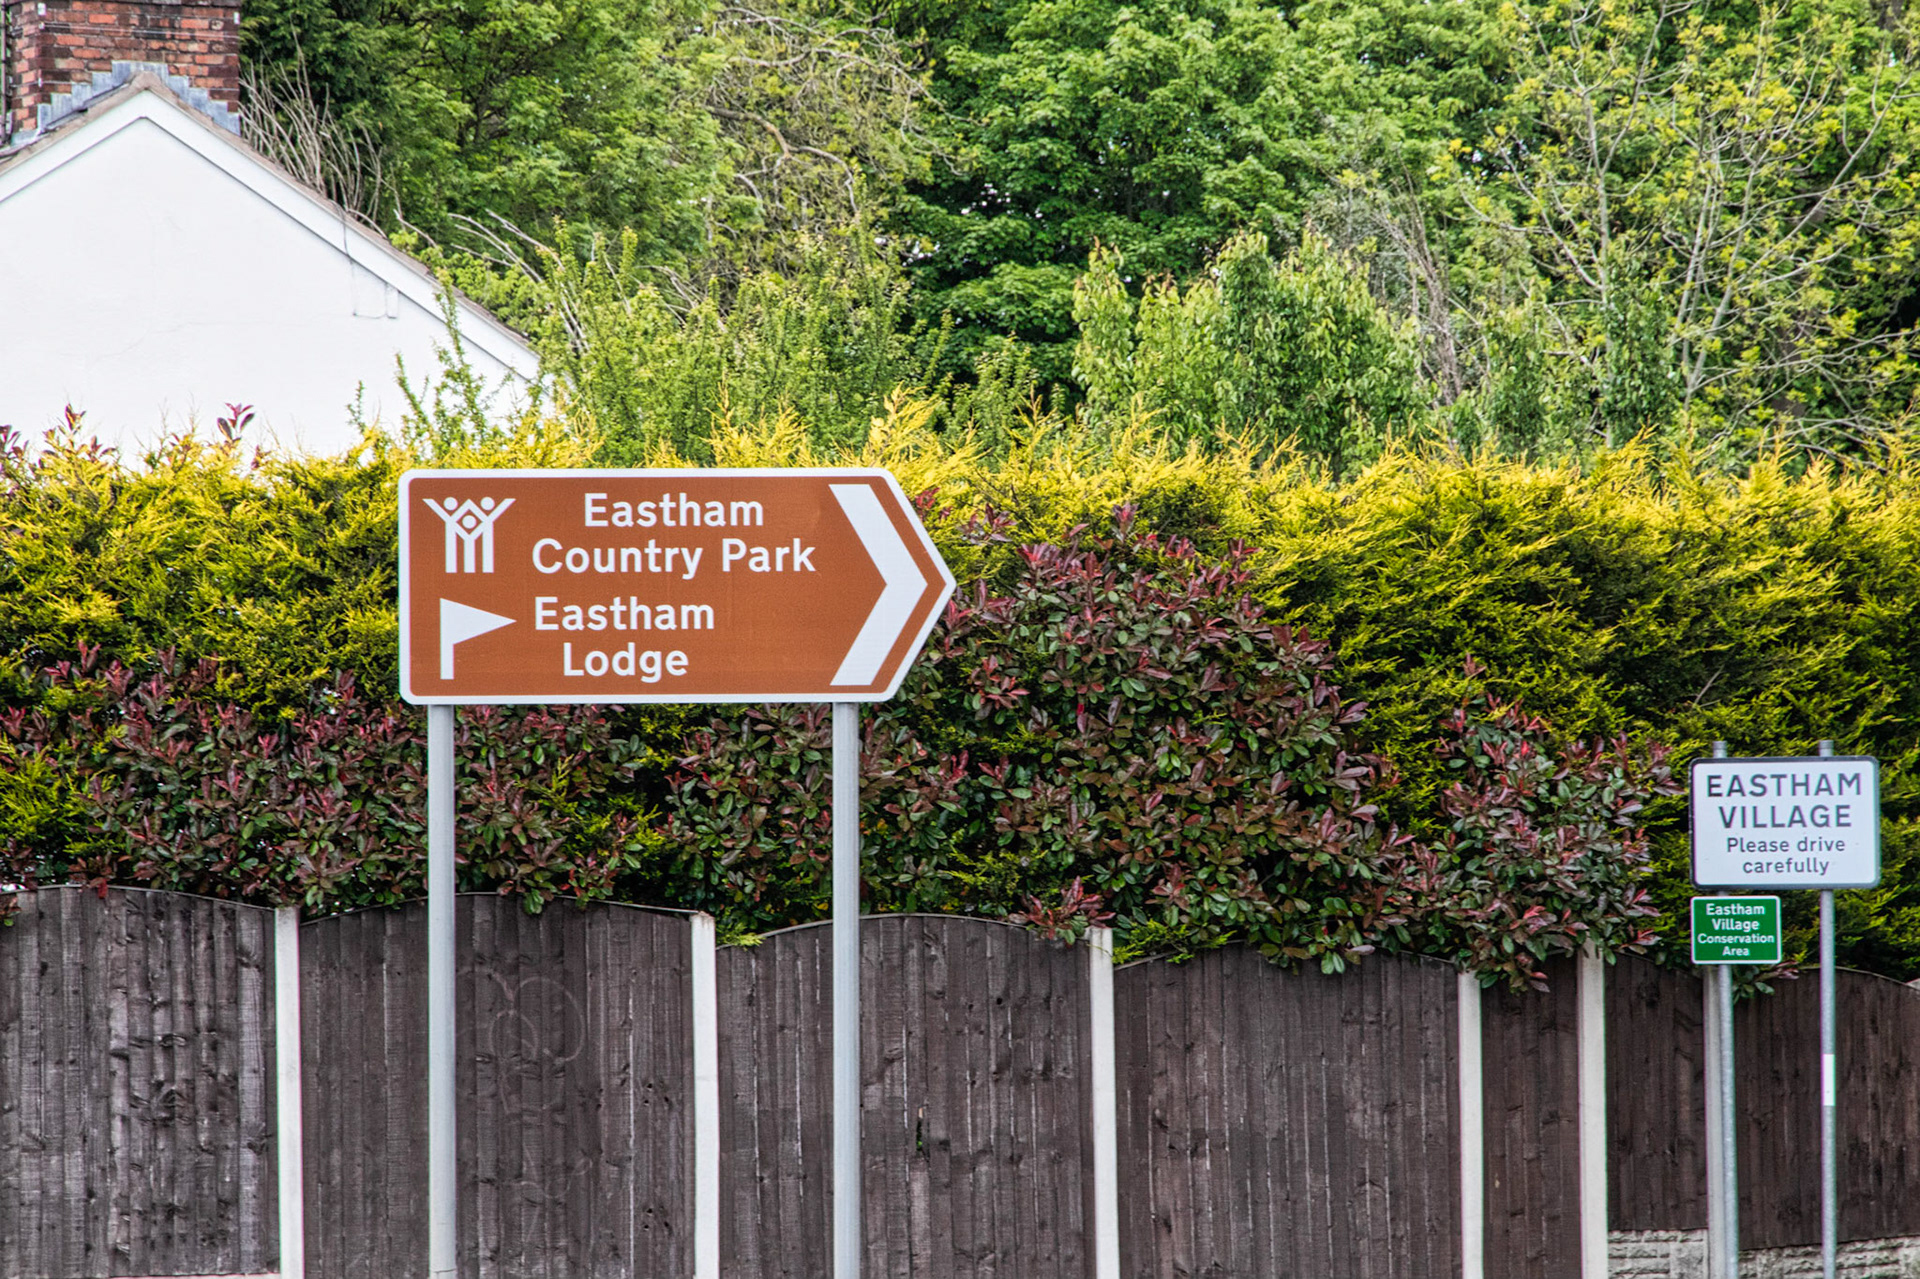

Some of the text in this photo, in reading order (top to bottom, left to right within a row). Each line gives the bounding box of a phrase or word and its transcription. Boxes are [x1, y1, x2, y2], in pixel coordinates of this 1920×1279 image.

[584, 492, 764, 528] Eastham
[532, 537, 816, 581] Country Park
[535, 595, 715, 631] Eastham
[563, 642, 689, 684] Lodge
[1707, 773, 1861, 797] EASTHAM
[1718, 804, 1852, 829] VILLAGE
[1726, 836, 1846, 853] Please drive
[1742, 857, 1830, 876] carefully
[1705, 903, 1765, 916] Eastham
[1711, 917, 1760, 932] Village
[1697, 932, 1775, 944] Conservation
[1721, 945, 1750, 956] Area
